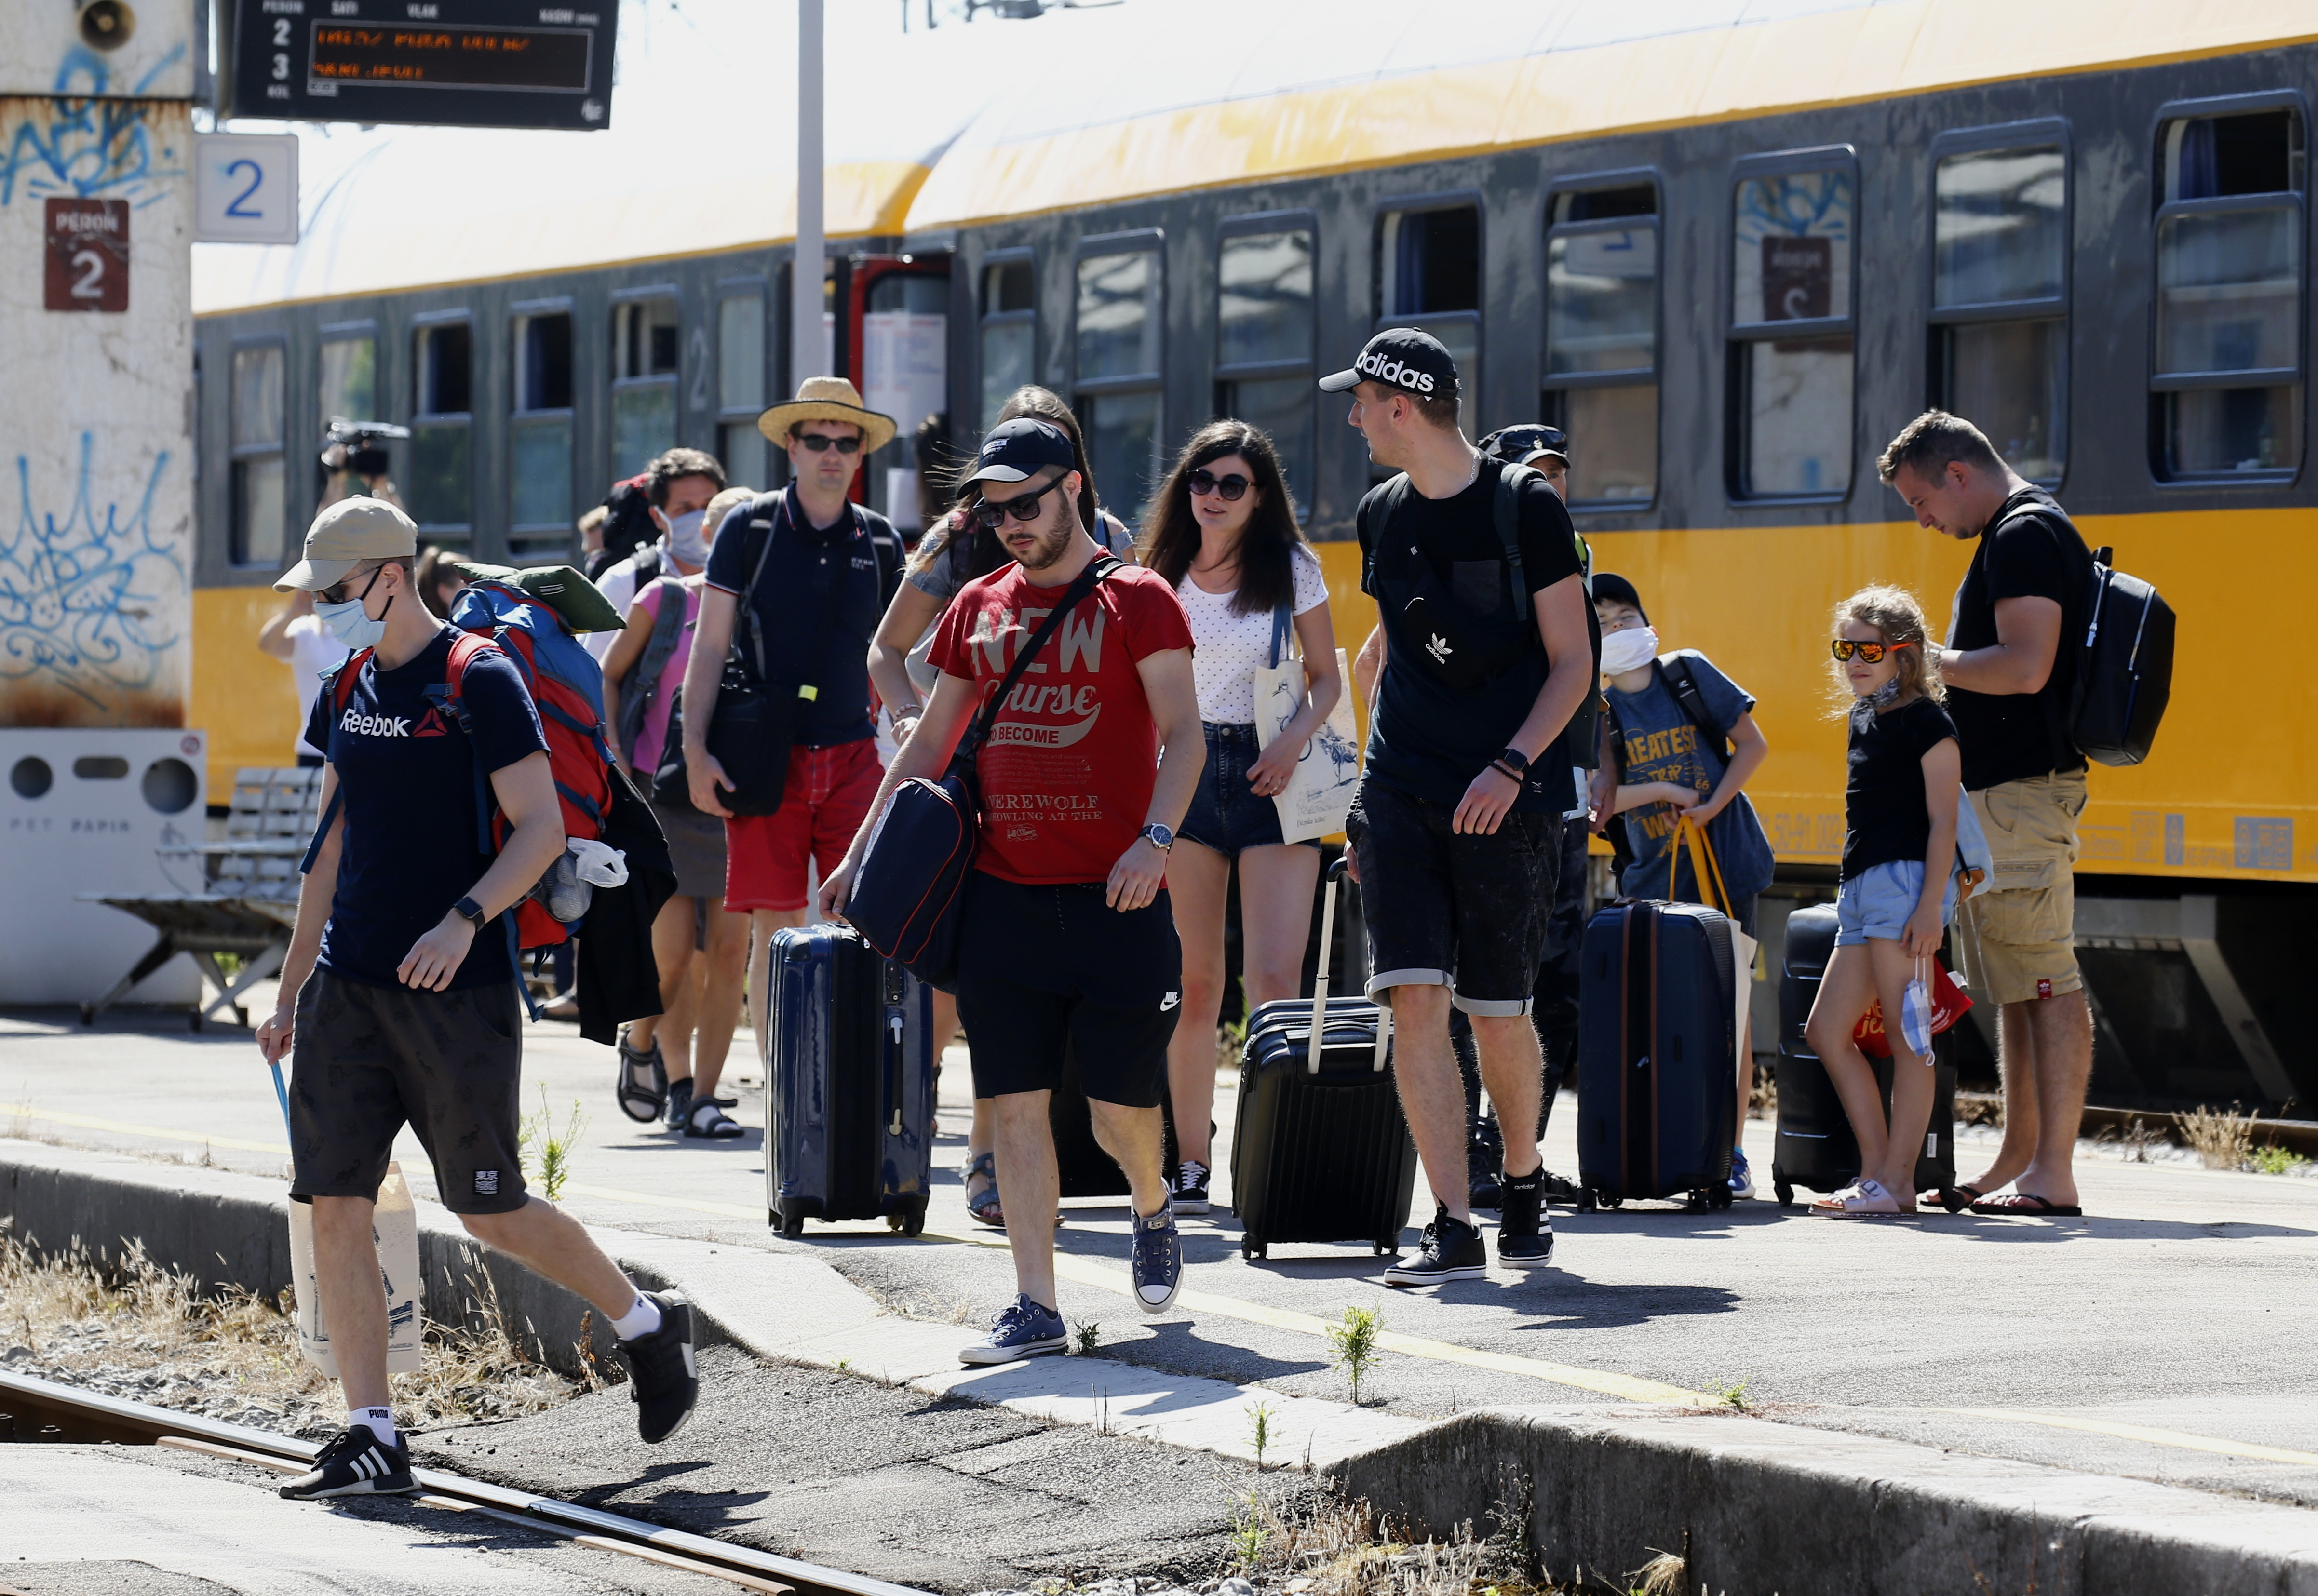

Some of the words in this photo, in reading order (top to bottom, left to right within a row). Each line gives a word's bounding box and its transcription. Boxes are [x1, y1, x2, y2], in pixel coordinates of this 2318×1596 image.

[273, 18, 291, 46] 2
[271, 53, 289, 80] 3
[225, 160, 263, 219] 2
[56, 211, 120, 232] PERON
[70, 249, 105, 298] 2
[1356, 351, 1435, 393] adidas
[968, 606, 1105, 676] NEW
[1425, 643, 1446, 665] adidas
[339, 708, 412, 737] Reebok
[998, 726, 1060, 744] BECOME
[9, 819, 52, 833] PET
[71, 819, 130, 833] PAPIR
[1049, 813, 1067, 821] AT
[1071, 811, 1102, 821] THE
[1164, 991, 1178, 1003] NIKE
[368, 1409, 389, 1419] PUMA
